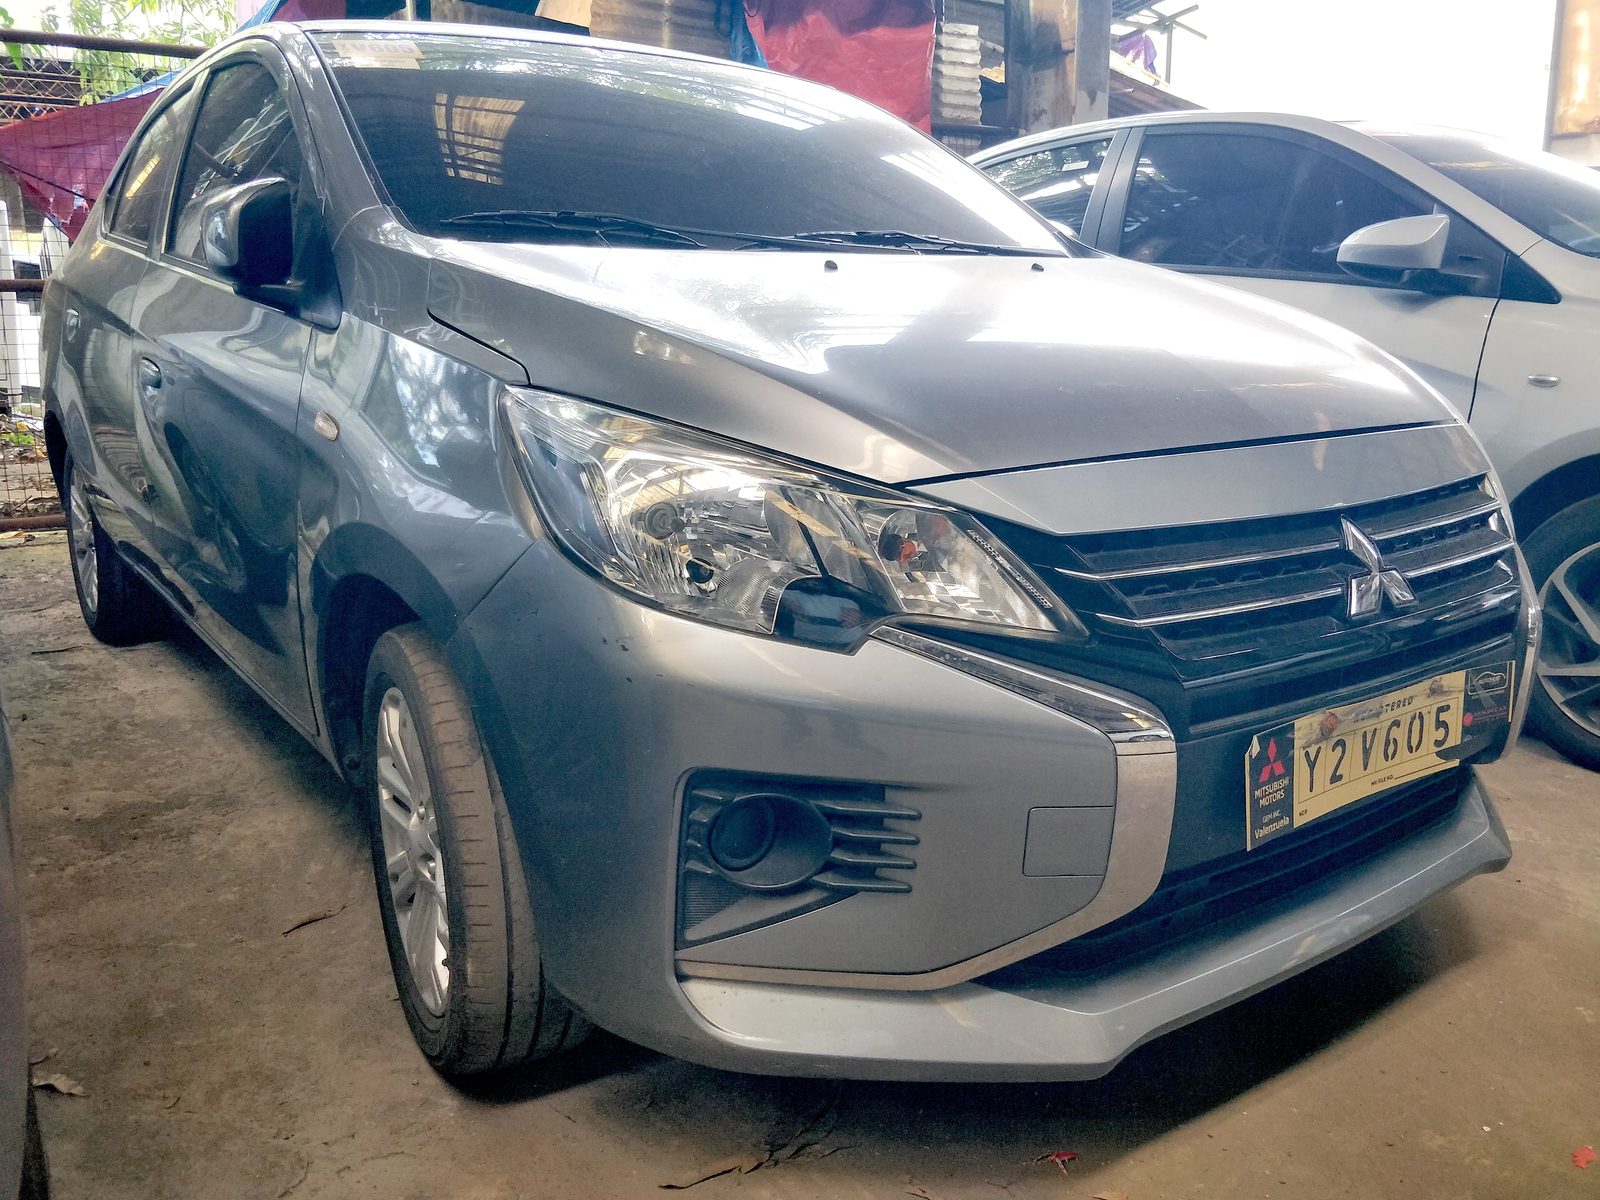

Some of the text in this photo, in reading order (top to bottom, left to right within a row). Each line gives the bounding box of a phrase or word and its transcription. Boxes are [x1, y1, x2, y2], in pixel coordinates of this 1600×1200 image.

[1255, 777, 1290, 799] MITSUBISHI
[1260, 789, 1285, 808] MOTORS
[1255, 816, 1290, 839] Valenzuela
